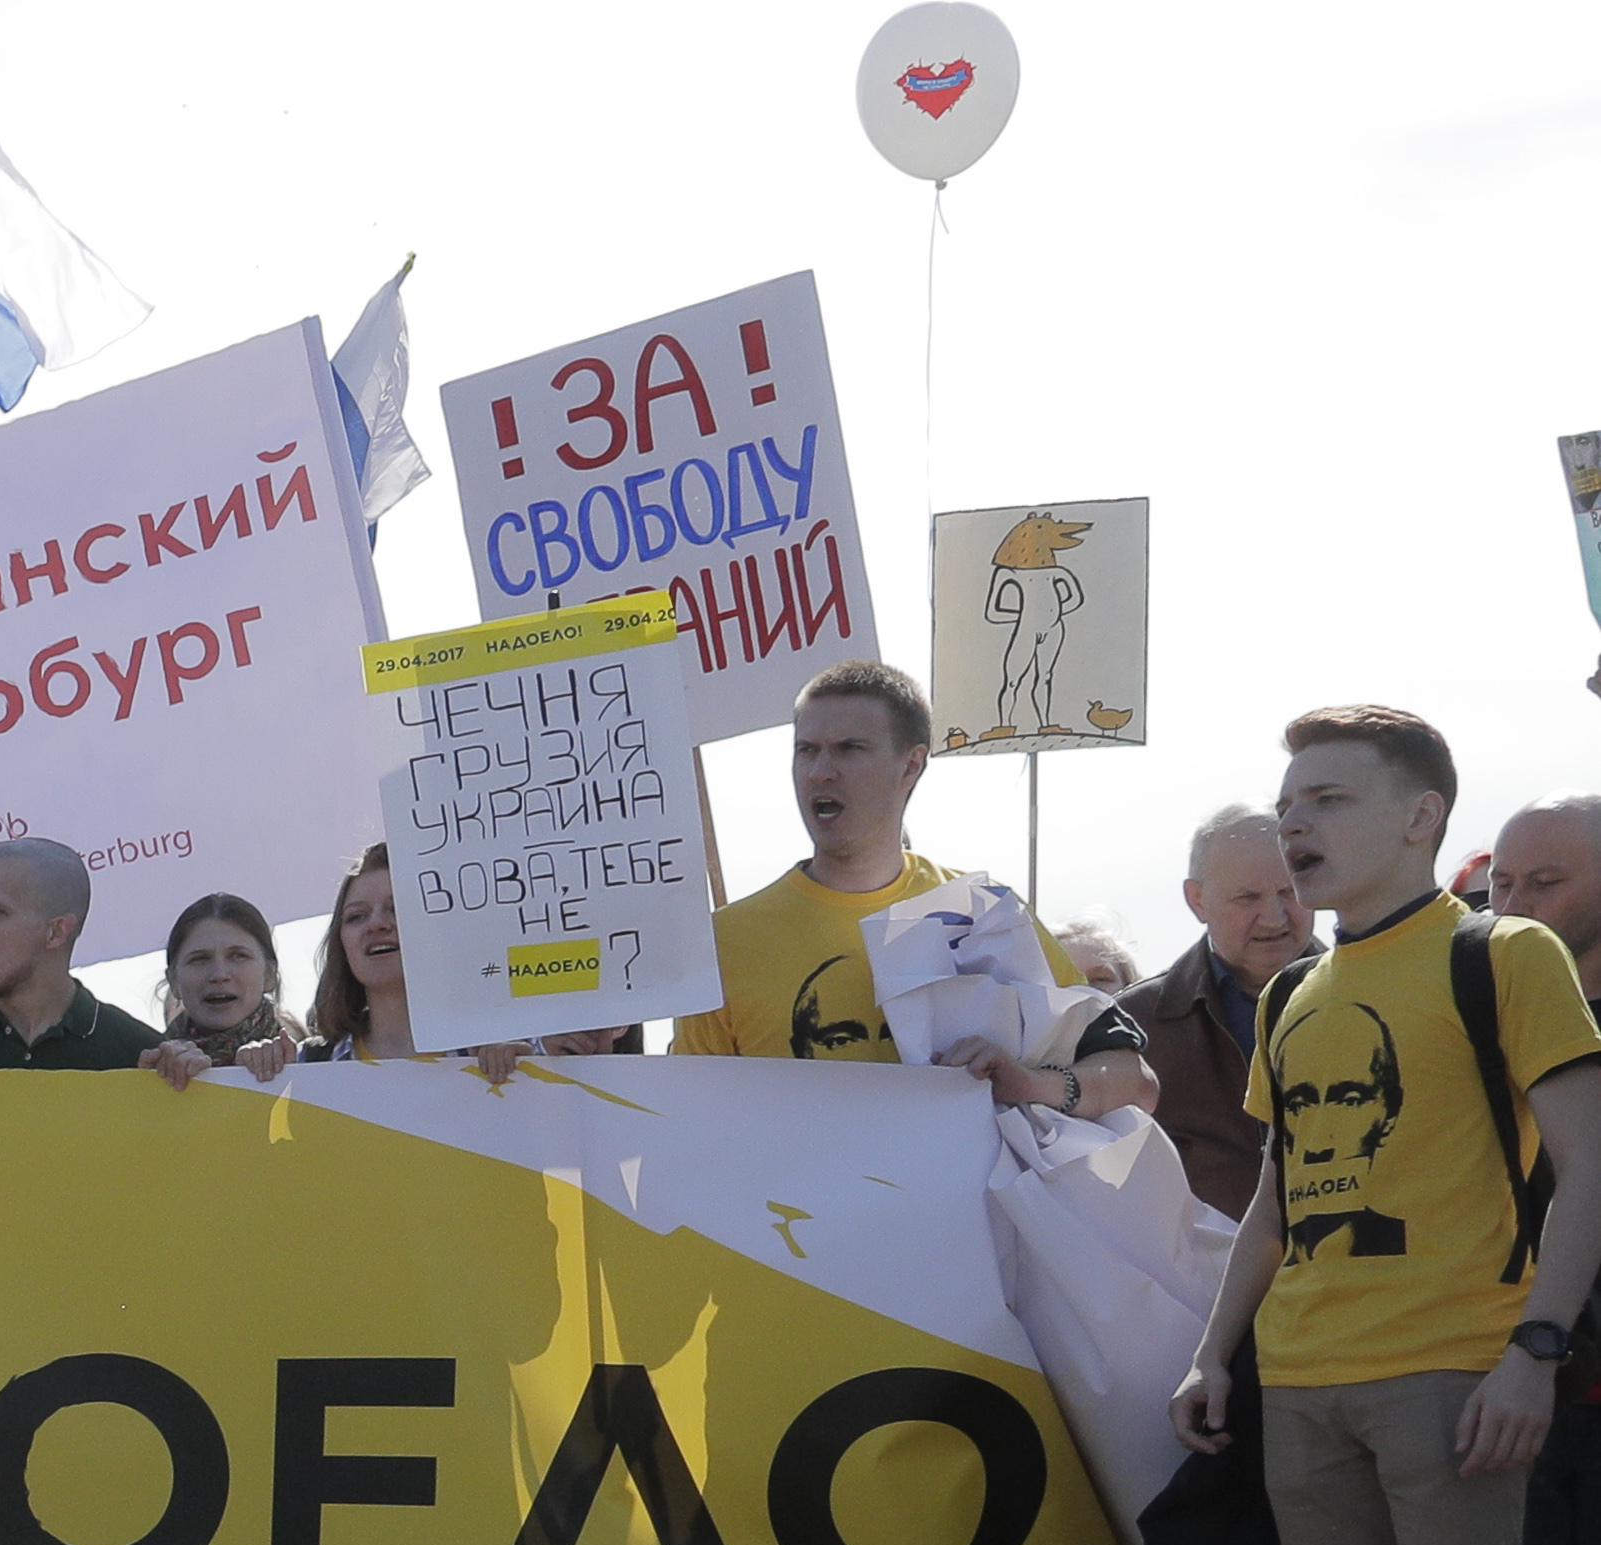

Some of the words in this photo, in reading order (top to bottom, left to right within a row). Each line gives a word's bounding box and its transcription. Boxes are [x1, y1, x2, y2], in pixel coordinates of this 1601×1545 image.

[487, 424, 818, 596] СВОБОДУ
[669, 519, 852, 674] АНИЙ
[376, 646, 465, 673] 29.04.2017
[486, 625, 583, 654] НАДОЕЛО!
[398, 663, 632, 739] ЧЕЧНЯ
[409, 720, 650, 801] ГРУЗИЯ
[412, 770, 665, 855] УКРАИНА
[518, 898, 591, 934] НЕ
